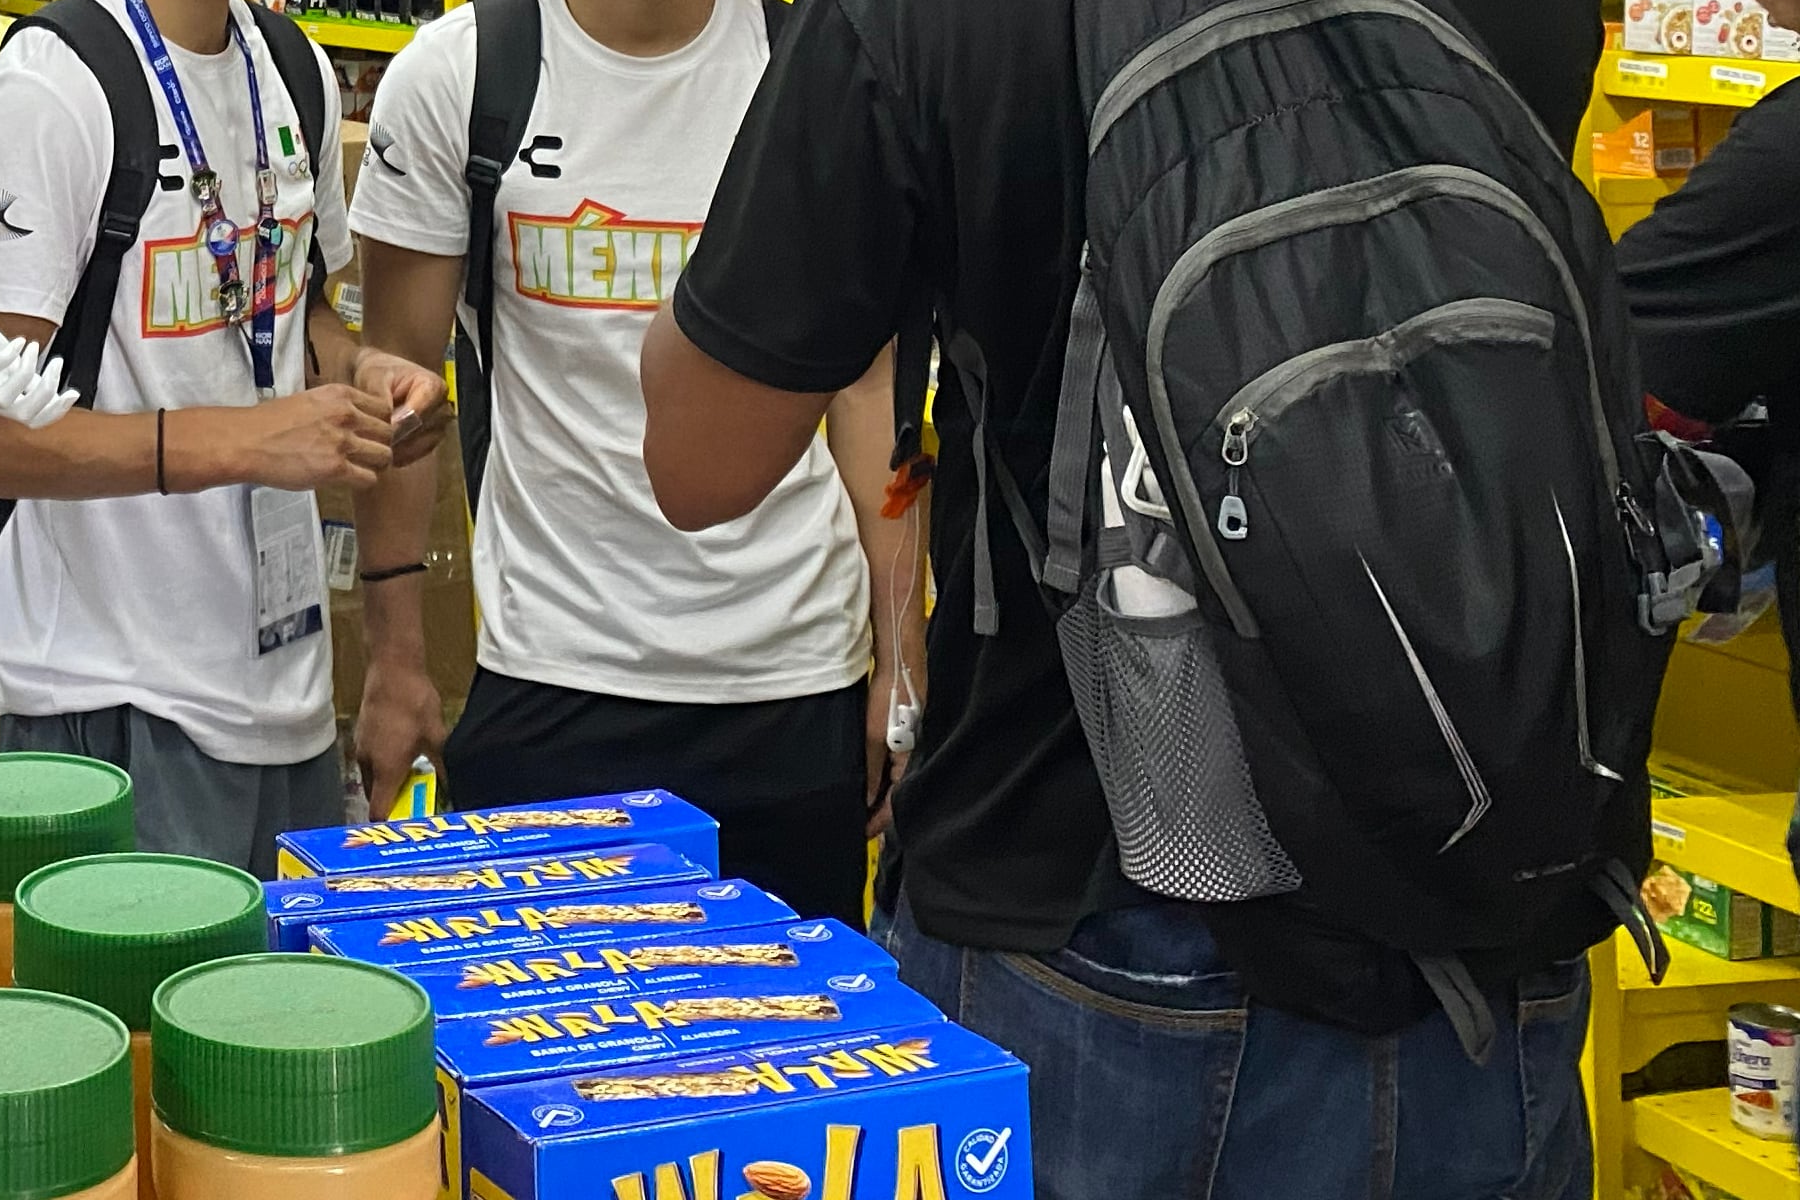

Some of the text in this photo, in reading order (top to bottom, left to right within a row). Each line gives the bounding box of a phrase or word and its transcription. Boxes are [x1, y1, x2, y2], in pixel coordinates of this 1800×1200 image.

[517, 211, 700, 301] MÉXI
[347, 813, 511, 846] WALA
[458, 856, 632, 889] WALA
[385, 906, 568, 943] WALA
[463, 948, 654, 986] WALA
[490, 1000, 692, 1043] WALA
[529, 1034, 662, 1058] BARRA DE GRANOLA
